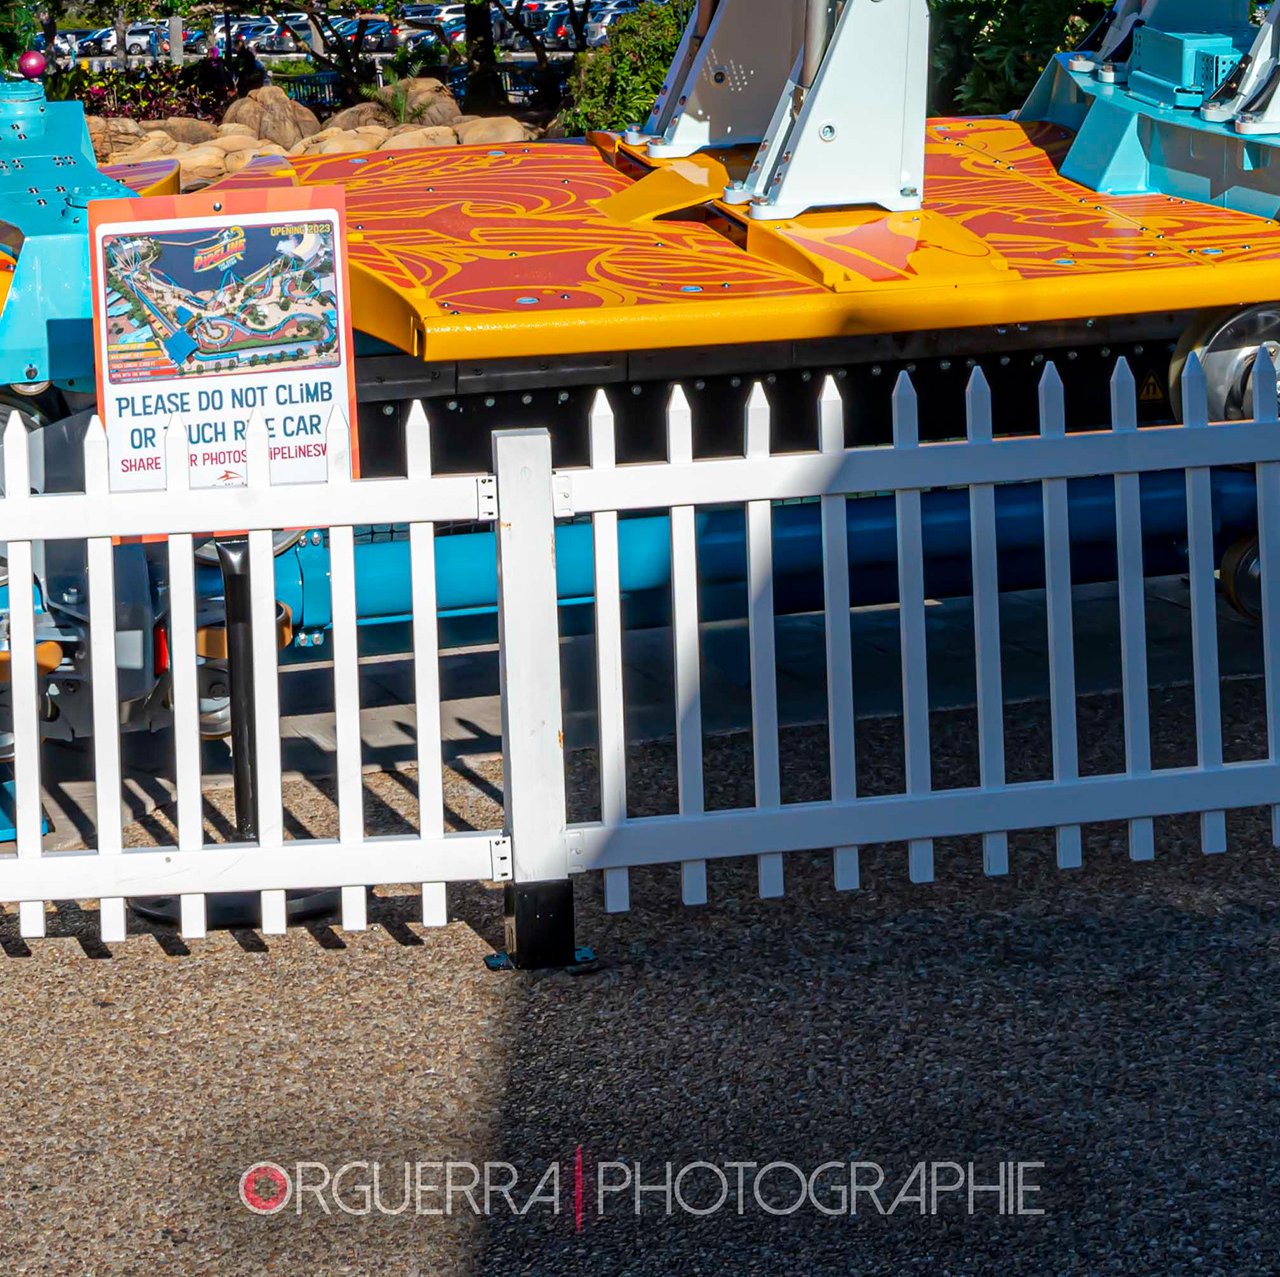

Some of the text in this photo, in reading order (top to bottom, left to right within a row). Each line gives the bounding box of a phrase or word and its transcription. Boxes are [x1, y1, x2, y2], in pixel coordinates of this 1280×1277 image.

[270, 223, 331, 236] OPENING 2023
[193, 238, 247, 271] PIPELINE
[116, 392, 191, 418] PLEASE
[198, 389, 224, 411] DO
[231, 386, 268, 409] NOT
[130, 427, 156, 449] OR
[163, 422, 226, 445] UCH
[282, 414, 322, 437] CAR
[121, 456, 162, 473] SHARE
[202, 449, 247, 466] PHOTOS
